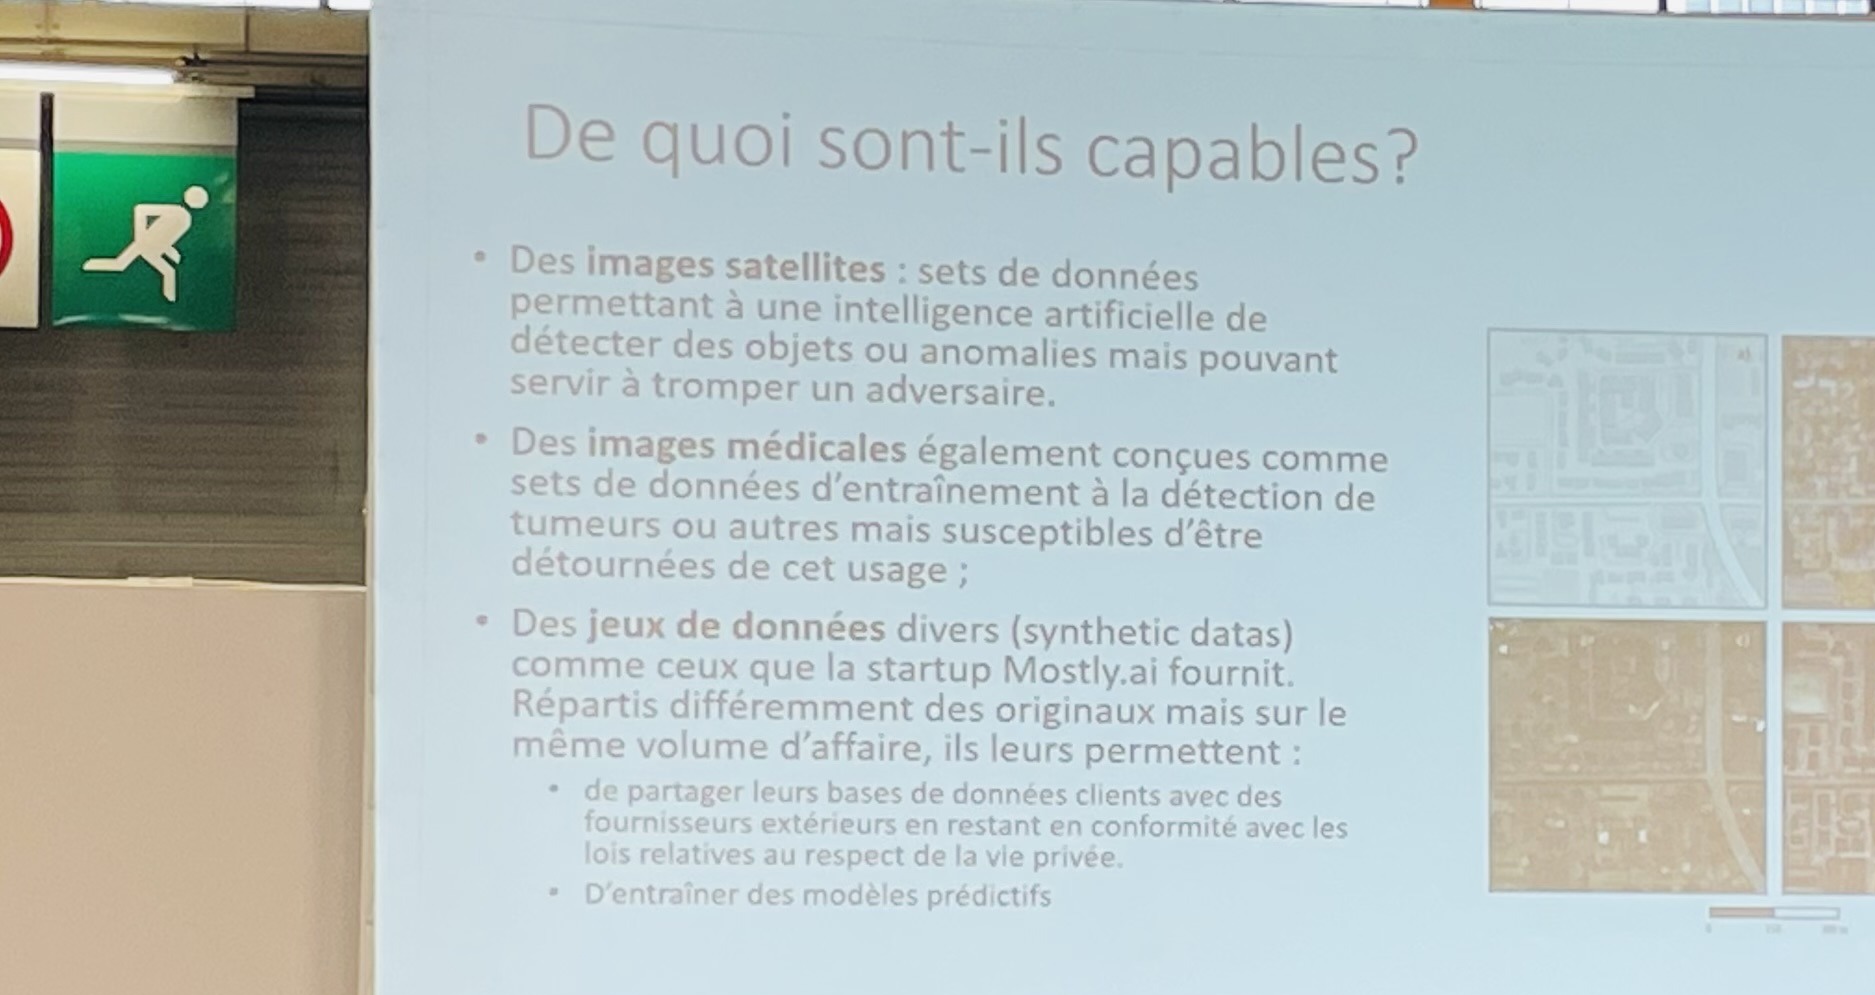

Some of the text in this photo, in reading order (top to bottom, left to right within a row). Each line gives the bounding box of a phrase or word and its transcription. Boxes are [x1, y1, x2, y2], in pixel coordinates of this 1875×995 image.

[527, 103, 1418, 195] De quoi sont-ils capables?
[511, 244, 575, 275] Des
[587, 244, 715, 285] images
[725, 250, 886, 284] satellites
[918, 259, 987, 287] sets
[998, 256, 1040, 288] de
[1051, 257, 1199, 292] données
[511, 288, 1267, 333] permettant à une intelligence artificielle de
[510, 323, 1339, 378] détecter des objets ou anomalies mais pouvant
[510, 366, 1056, 408] servir à tromper un adversaire.
[512, 425, 1389, 476] Des images médicales également conçues comme
[510, 470, 581, 497] sets
[593, 467, 637, 499] de
[648, 468, 801, 502] données
[1091, 476, 1109, 508] à
[1122, 476, 1149, 508] la
[1161, 478, 1323, 512] détection
[1334, 481, 1376, 512] de
[509, 510, 661, 539] tumeurs
[671, 517, 716, 540] ou
[728, 514, 839, 542] autres
[851, 513, 931, 544] mais
[941, 515, 1154, 553] susceptibles
[511, 545, 716, 580] détournées
[727, 549, 771, 581] de
[782, 555, 836, 582] cet
[847, 560, 948, 590] usage
[513, 607, 1293, 655] Des jeux de données divers (synthetic datas)
[511, 650, 1295, 692] comme ceux que la startup Mostly.ai fournit.
[513, 686, 1347, 731] Répartis différemment des originaux mais sur le
[513, 727, 626, 759] même
[636, 728, 769, 760] volume
[944, 731, 979, 762] ils
[991, 732, 1074, 764] leurs
[1085, 738, 1281, 771] permettent
[584, 777, 1283, 809] de partager leurs bases de données clients avec des
[583, 808, 1349, 840] fournisseurs extérieurs en restant en conformité avec les
[584, 840, 1124, 874] lois relatives au respect de la vie privée.
[746, 881, 795, 906] des
[803, 882, 919, 907] modèles
[927, 882, 1052, 912] prédictifs
